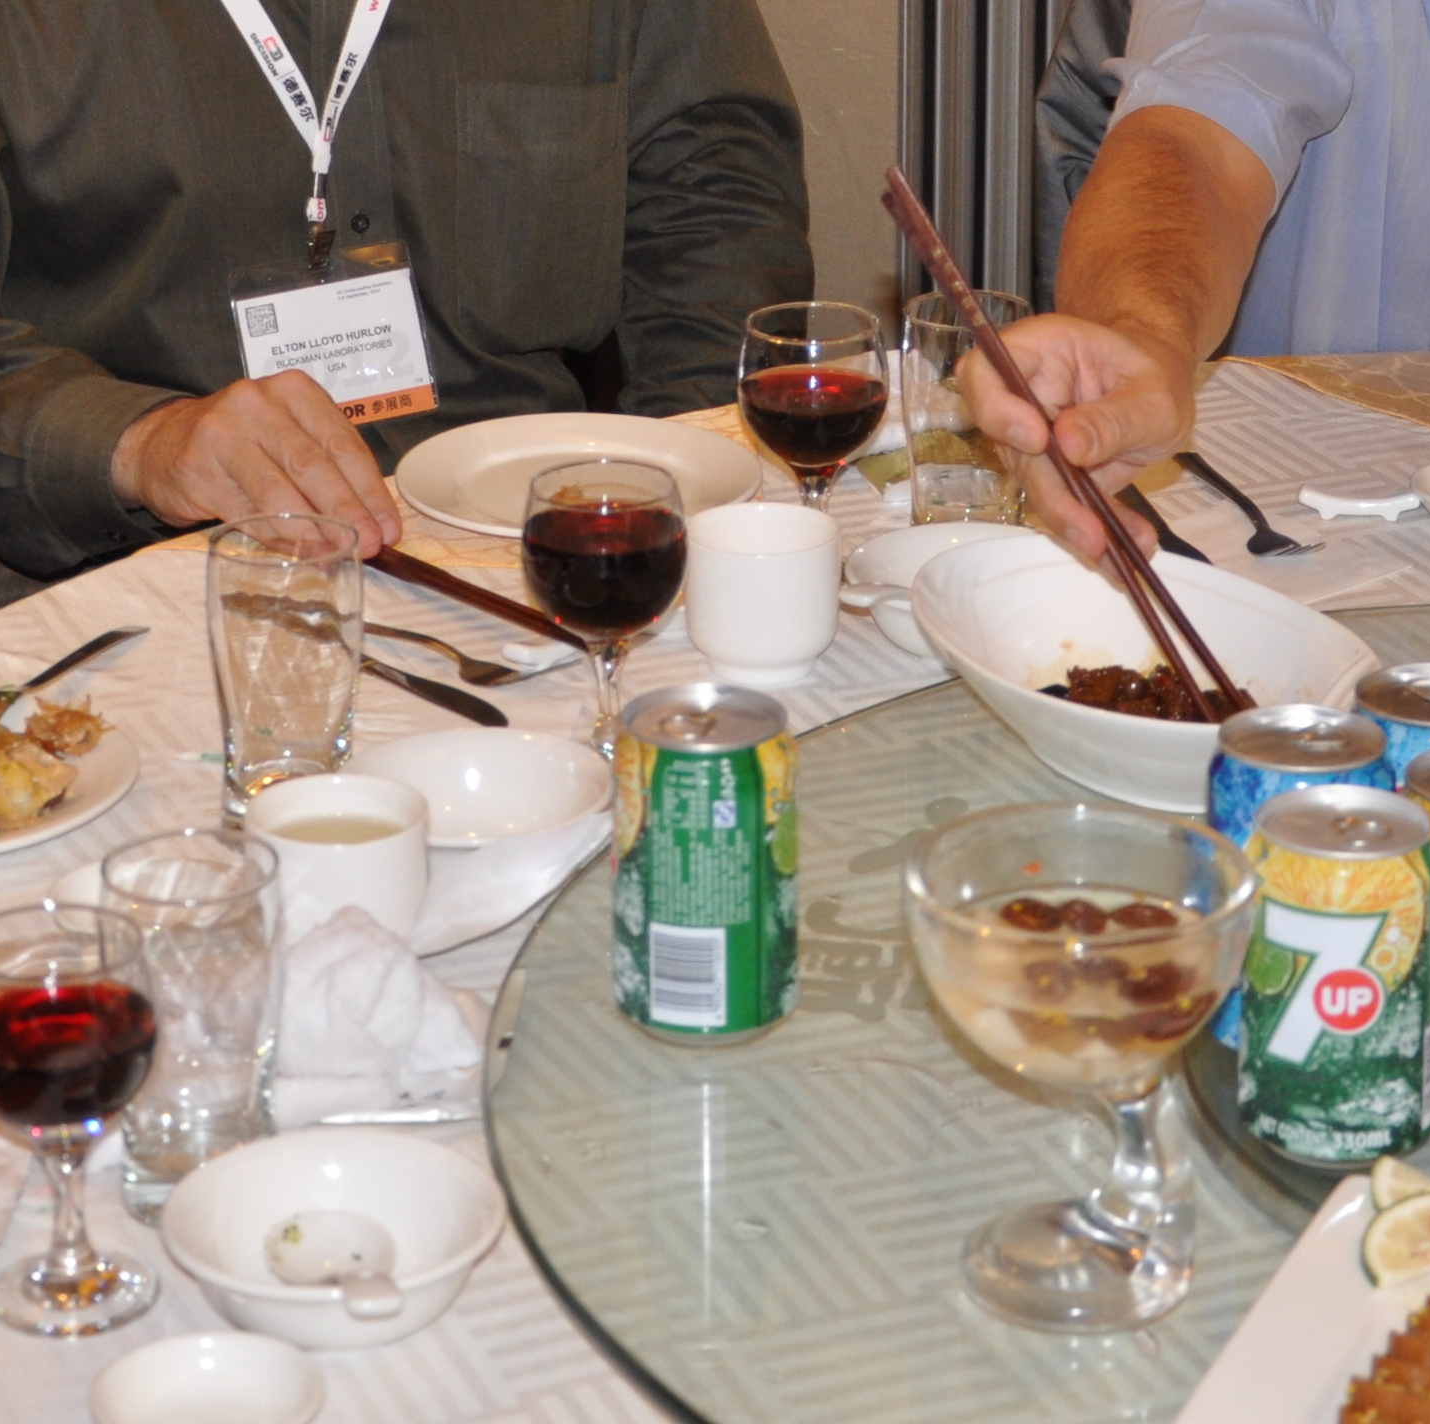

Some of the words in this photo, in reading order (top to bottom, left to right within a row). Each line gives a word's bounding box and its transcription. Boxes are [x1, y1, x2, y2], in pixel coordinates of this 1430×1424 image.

[271, 342, 307, 356] ELTON
[309, 334, 344, 349] LLOYD
[346, 324, 392, 341] HURLOW
[276, 353, 322, 369] BUCKMAN
[323, 339, 393, 360] LABORATORIES
[328, 362, 347, 372] USA
[1263, 900, 1386, 1064] 7
[1320, 985, 1373, 1018] UP
